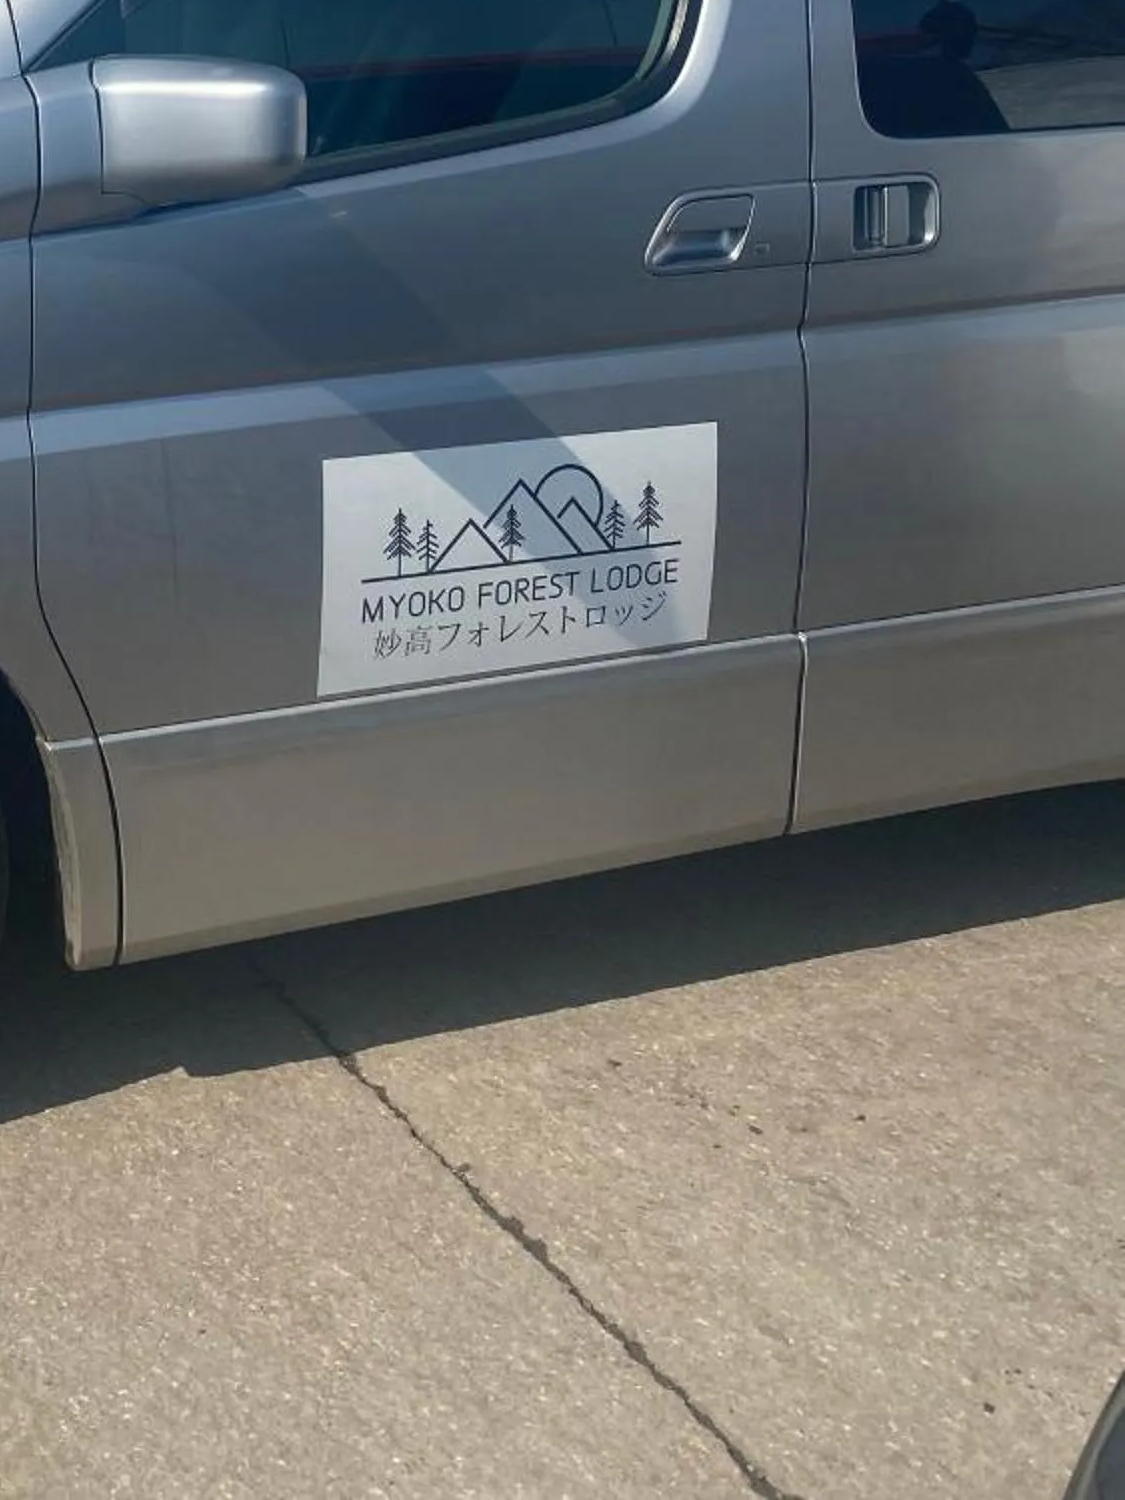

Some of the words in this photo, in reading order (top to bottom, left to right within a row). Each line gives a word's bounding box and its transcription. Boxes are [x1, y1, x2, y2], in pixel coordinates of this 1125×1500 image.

[361, 585, 465, 624] MYOKO
[478, 570, 580, 609] FOREST
[590, 557, 680, 594] LODGE
[373, 590, 668, 660] 妙高フォレストロッジ
